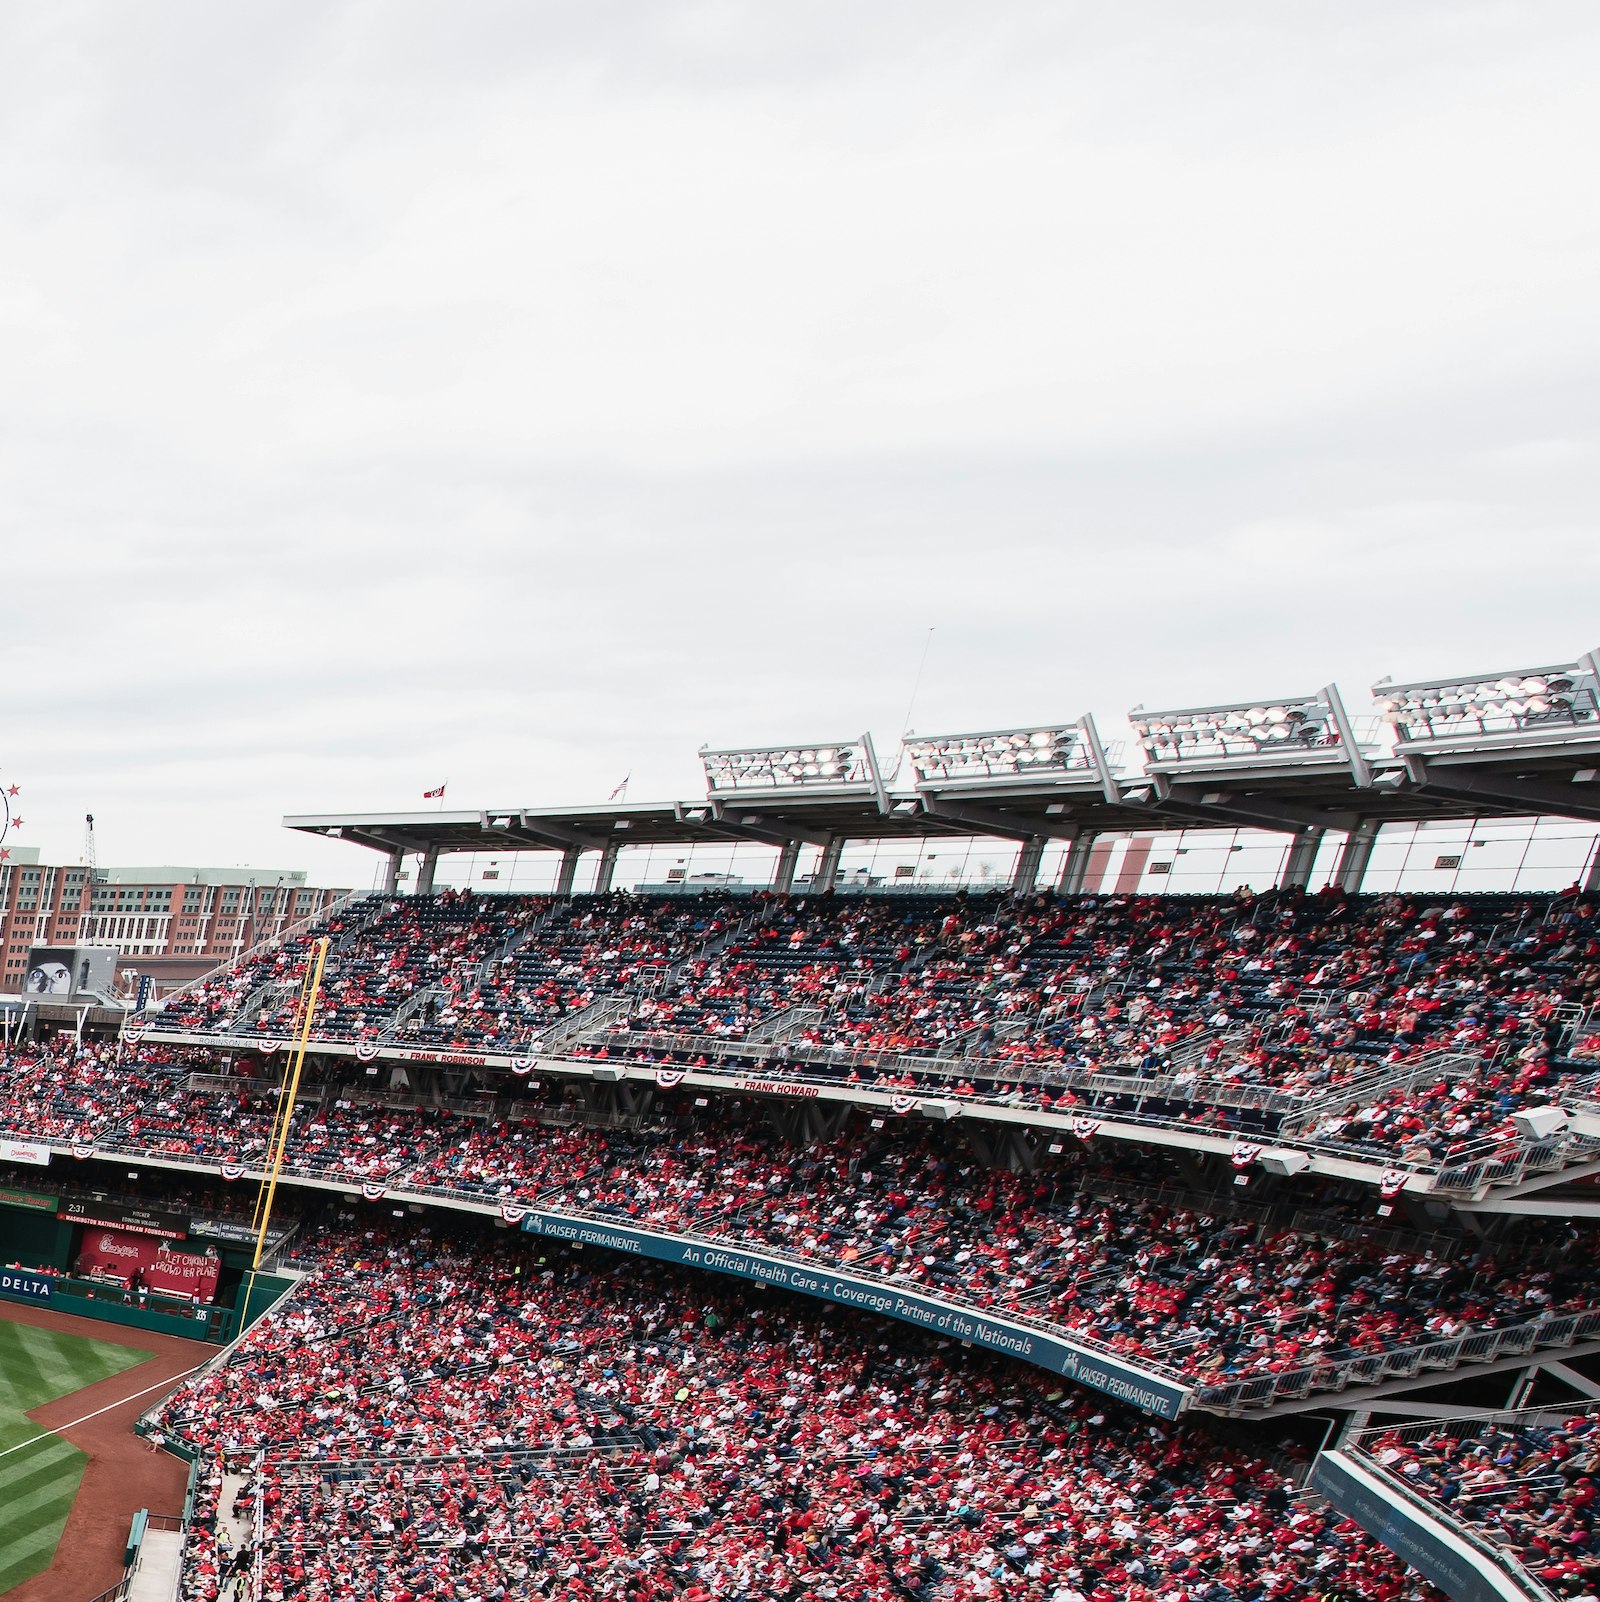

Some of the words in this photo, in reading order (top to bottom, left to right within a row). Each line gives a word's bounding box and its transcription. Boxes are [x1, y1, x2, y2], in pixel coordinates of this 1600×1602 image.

[410, 1051, 442, 1063] FRANK
[444, 1054, 486, 1066] ROBINSON
[744, 1079, 777, 1092] FRANK
[779, 1084, 819, 1097] HOWARD
[544, 1223, 578, 1239] KAISER
[579, 1229, 640, 1252] PERMANENTE
[1, 1276, 50, 1296] DELTA
[682, 1247, 701, 1263] An
[703, 1251, 749, 1273] Official
[749, 1260, 788, 1284] Health
[790, 1272, 818, 1291] Care
[833, 1284, 893, 1312] Coverage
[894, 1298, 937, 1325] Partner
[937, 1311, 952, 1329] of
[952, 1315, 972, 1334] the
[974, 1322, 1032, 1355] Nationals
[195, 1309, 207, 1321] 335
[1076, 1366, 1107, 1389] KAISER
[1108, 1376, 1170, 1414] PERMANENTE
